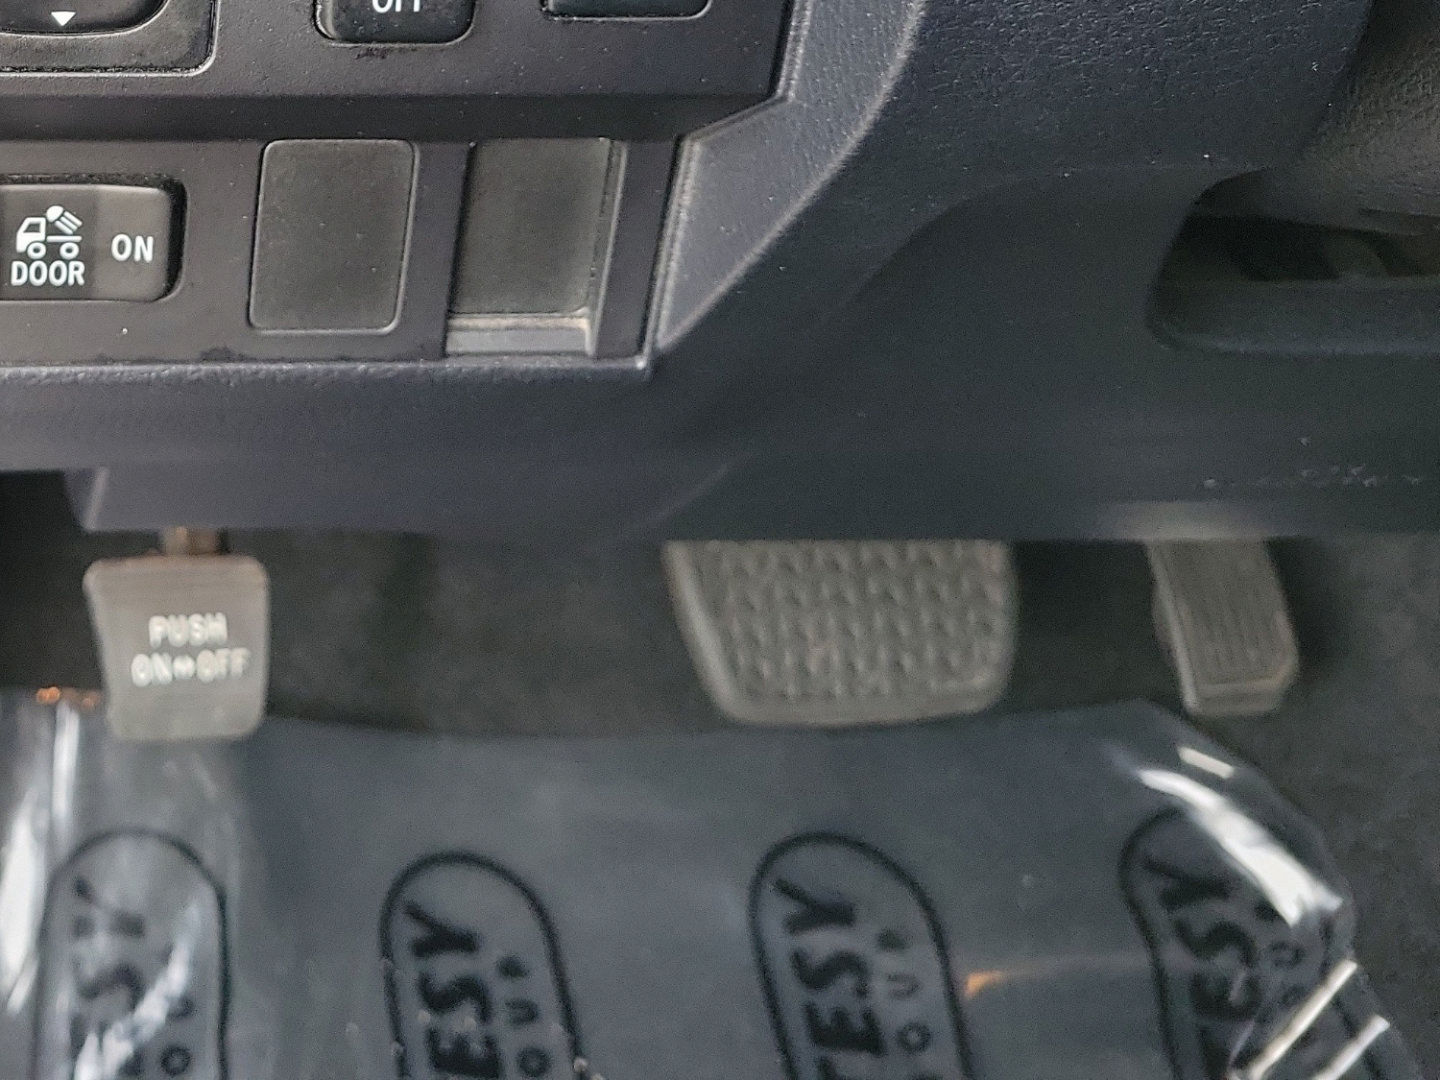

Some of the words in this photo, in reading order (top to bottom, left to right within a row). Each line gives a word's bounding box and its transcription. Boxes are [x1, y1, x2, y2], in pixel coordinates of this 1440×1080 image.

[111, 234, 154, 262] ON
[11, 261, 85, 286] DOOR
[149, 612, 228, 647] PUSH
